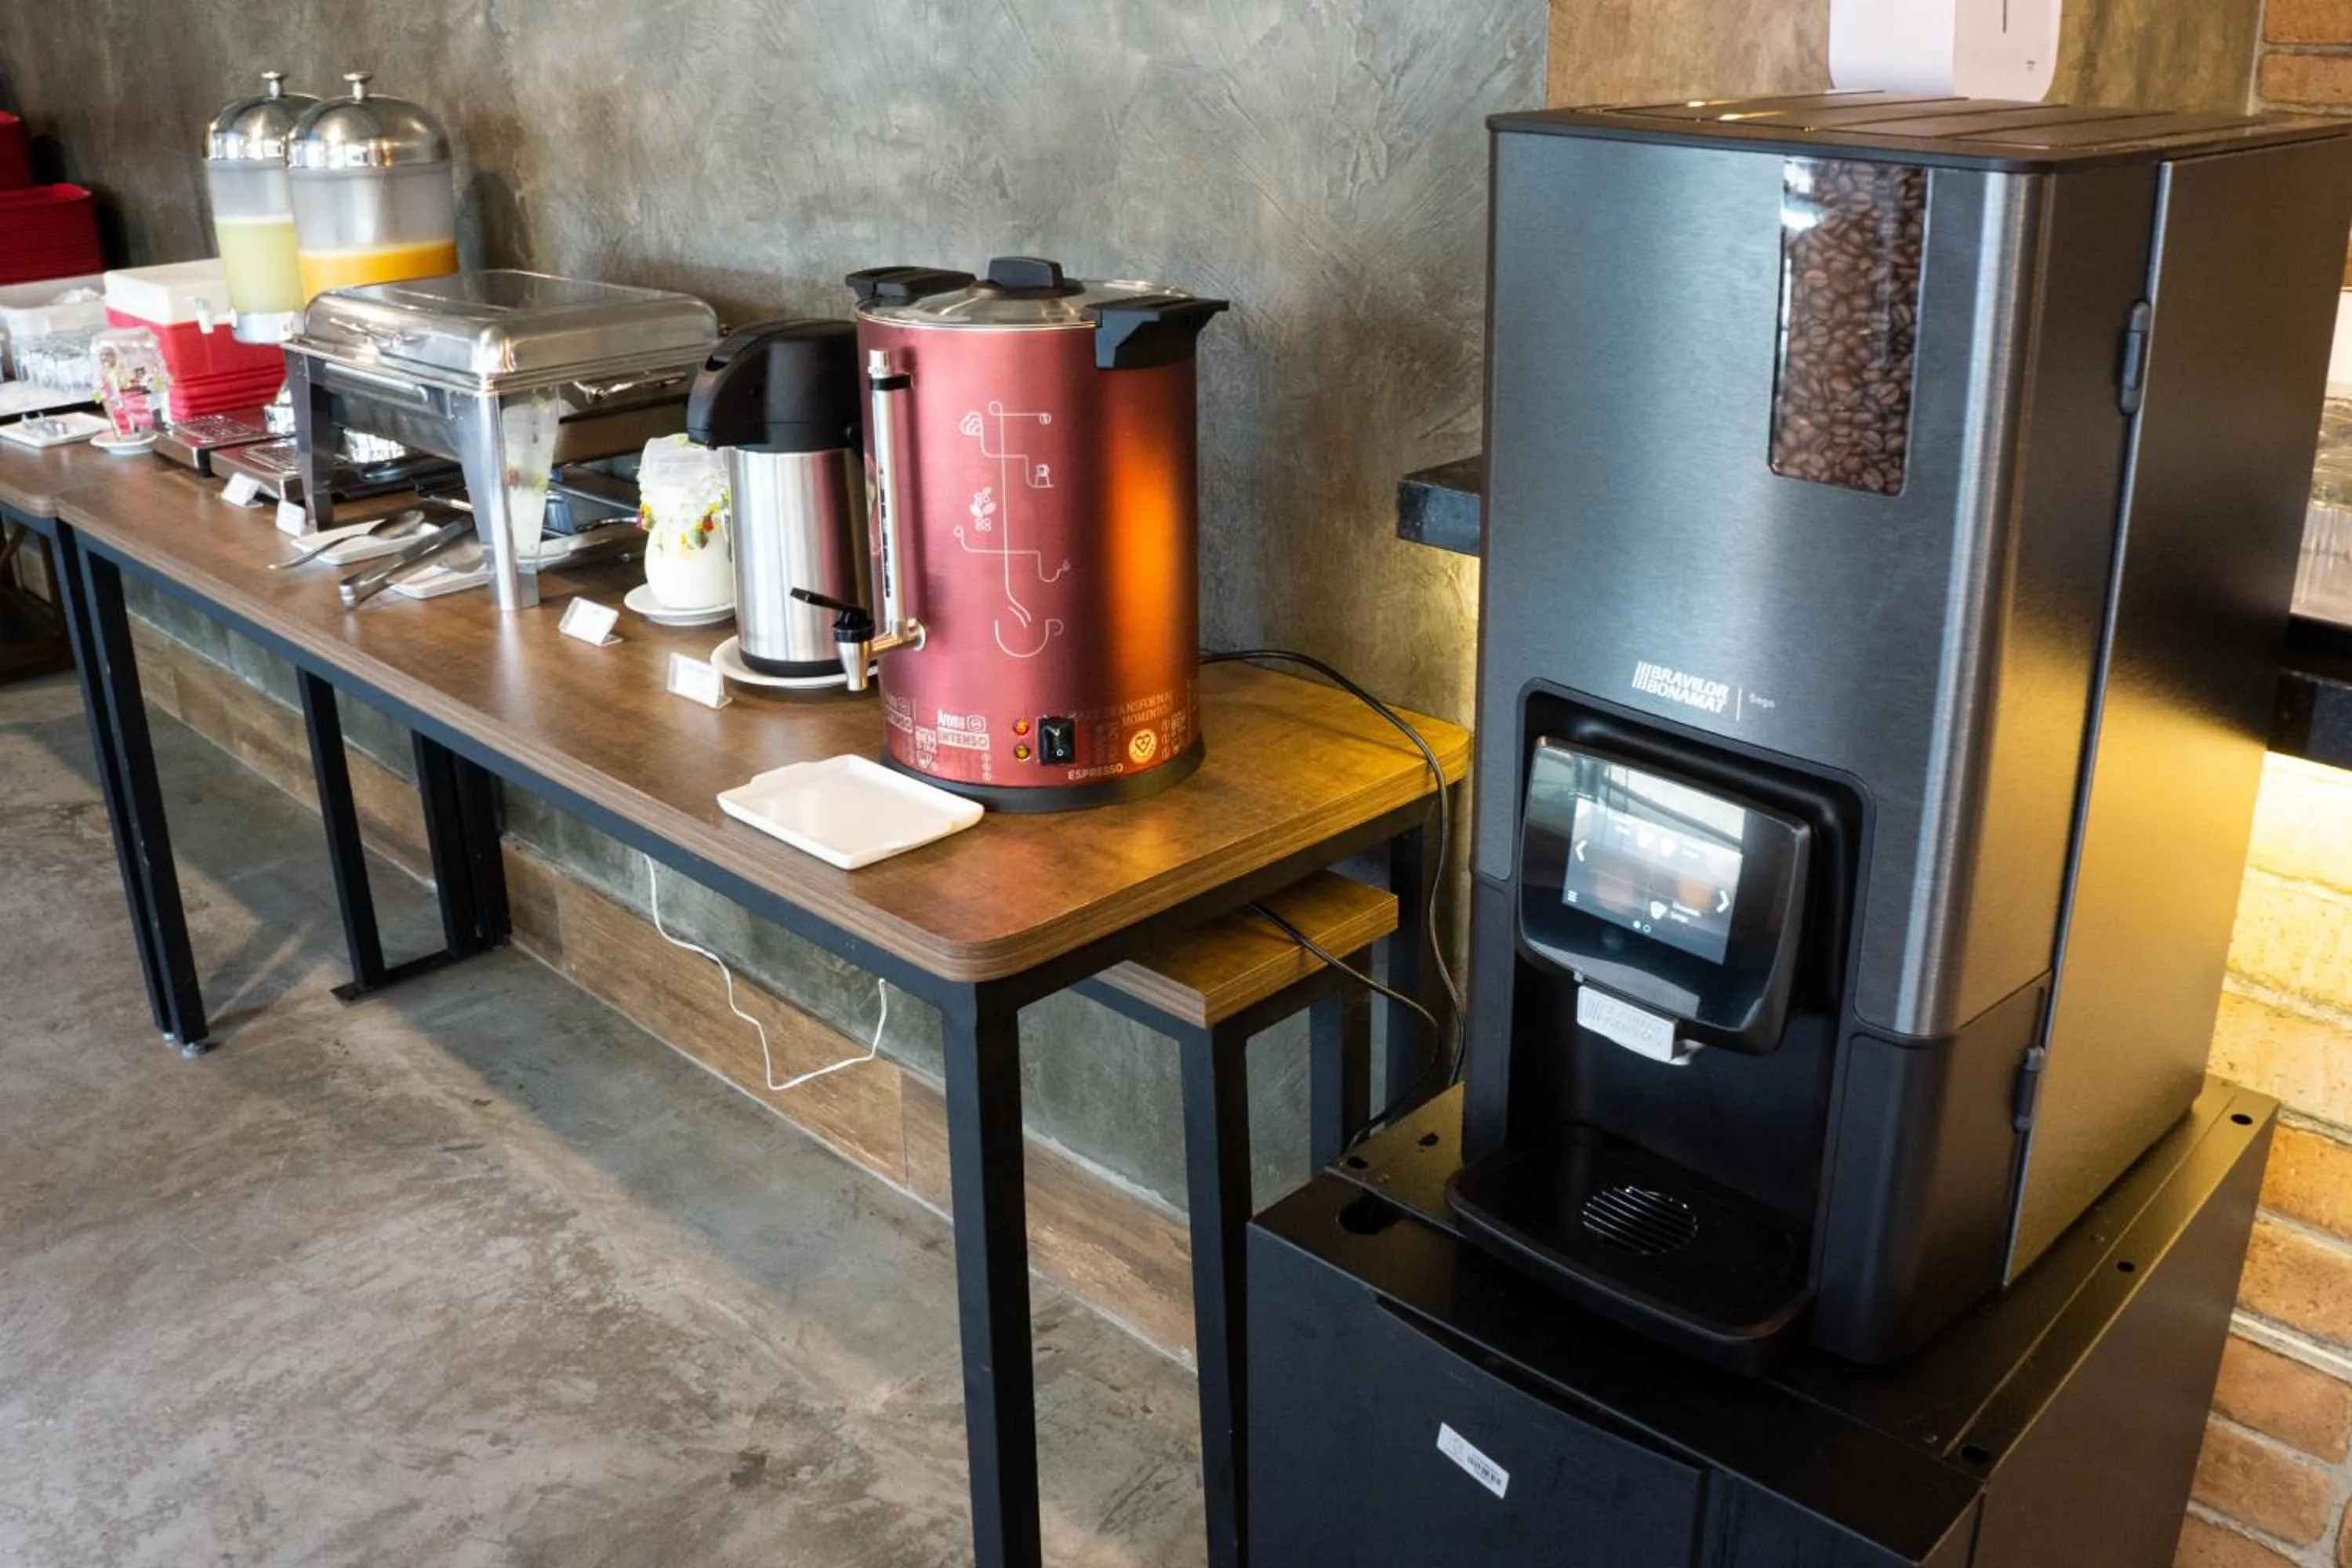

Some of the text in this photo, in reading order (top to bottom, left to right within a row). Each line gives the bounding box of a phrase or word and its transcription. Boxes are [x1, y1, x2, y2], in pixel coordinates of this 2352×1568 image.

[1647, 680, 1726, 713] BONAMAT
[1650, 666, 1730, 699] BRAVILOR
[1067, 763, 1123, 780] ESPRESSO
